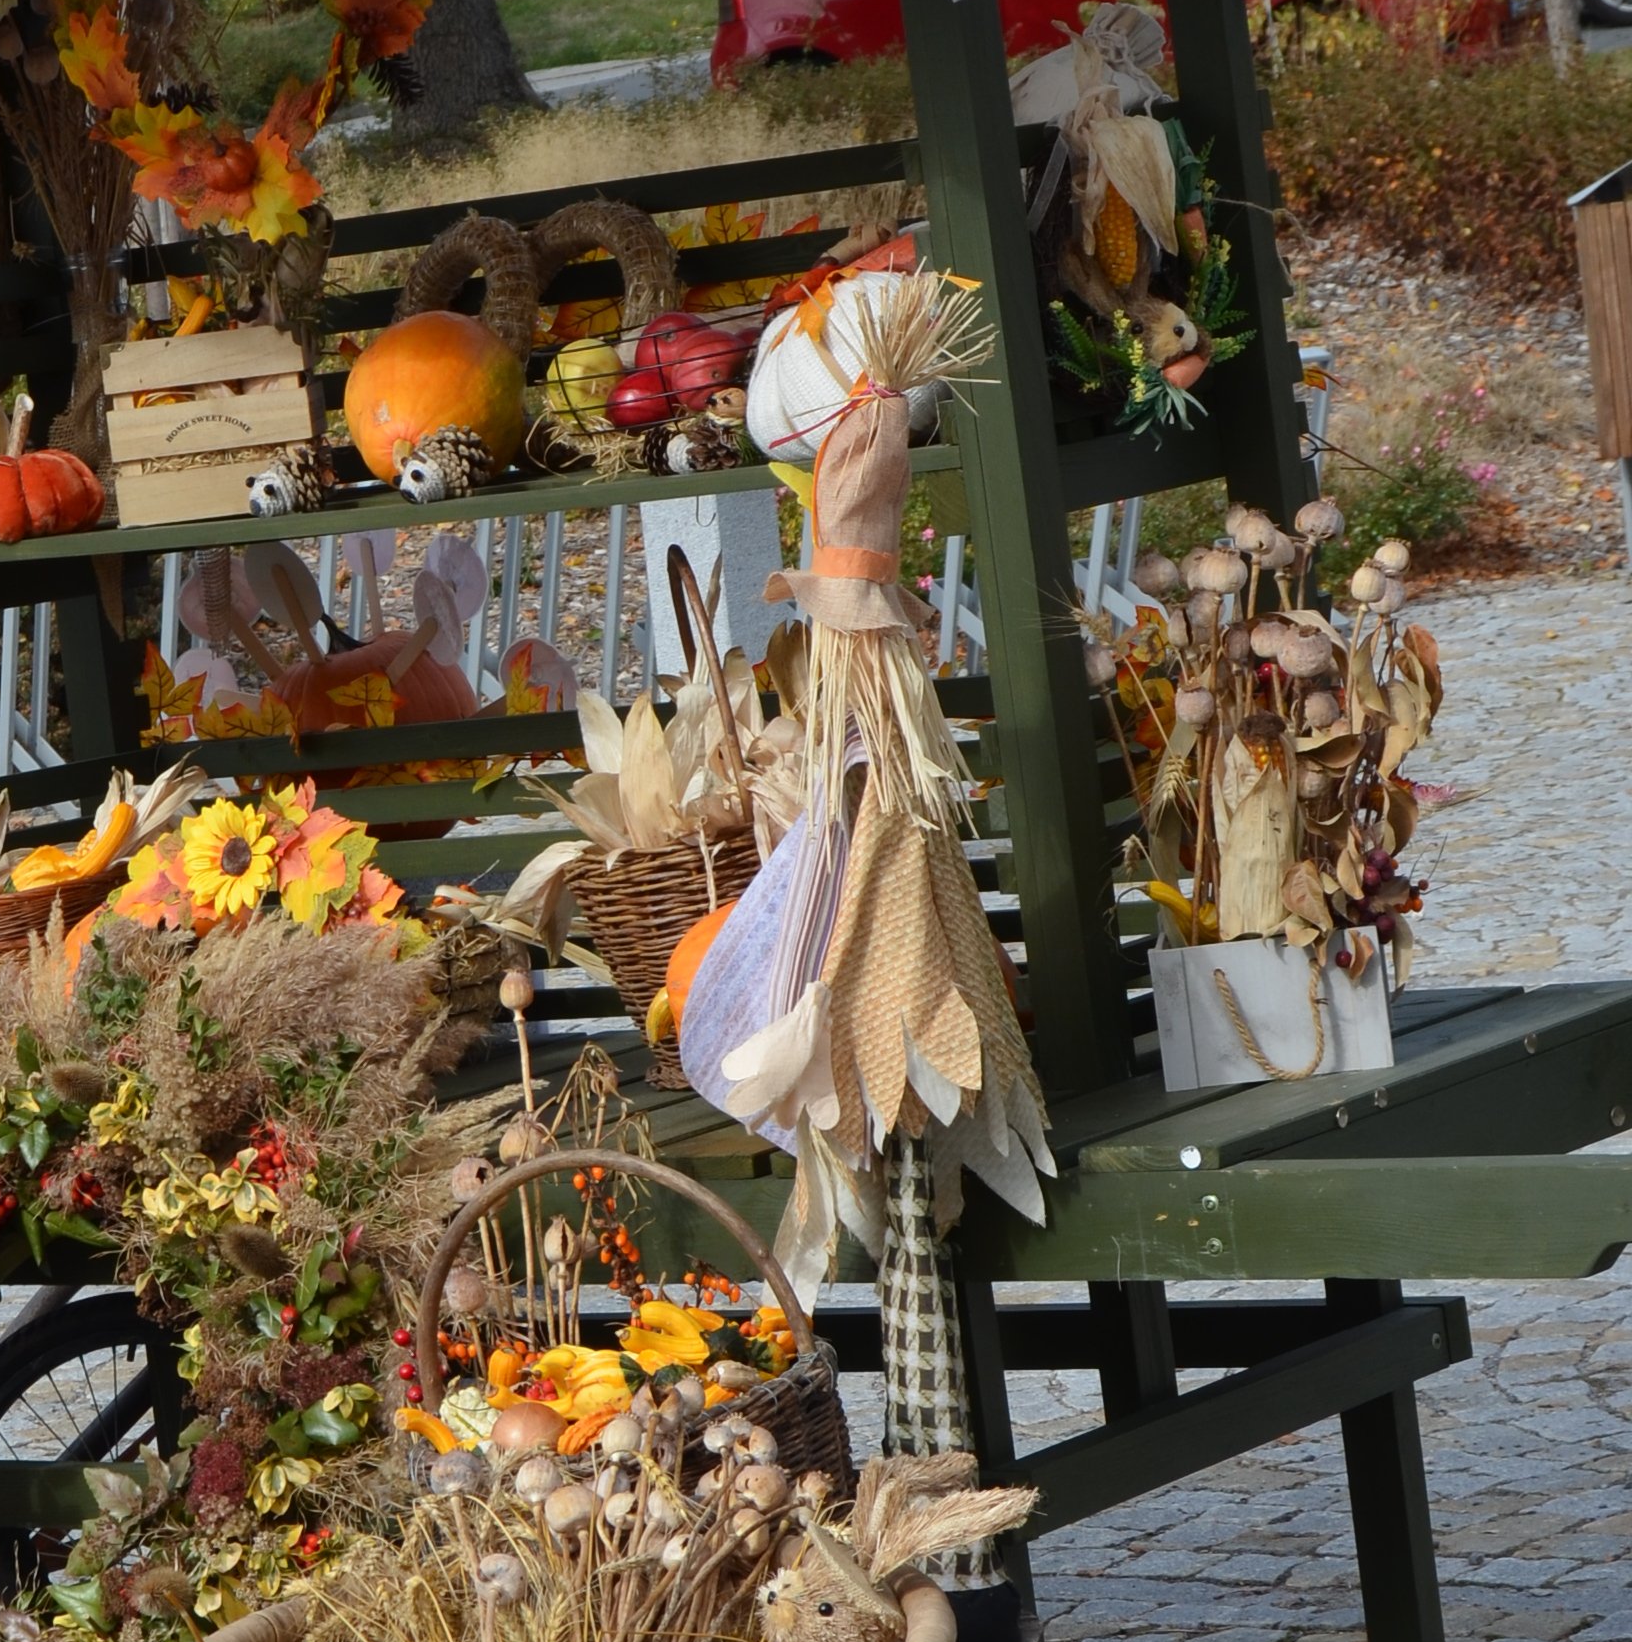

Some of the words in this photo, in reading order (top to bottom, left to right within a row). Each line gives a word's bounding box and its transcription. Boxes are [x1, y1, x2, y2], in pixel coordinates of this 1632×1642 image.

[166, 421, 191, 443] HOME
[191, 415, 223, 425] SWEET
[224, 416, 252, 433] HOME
